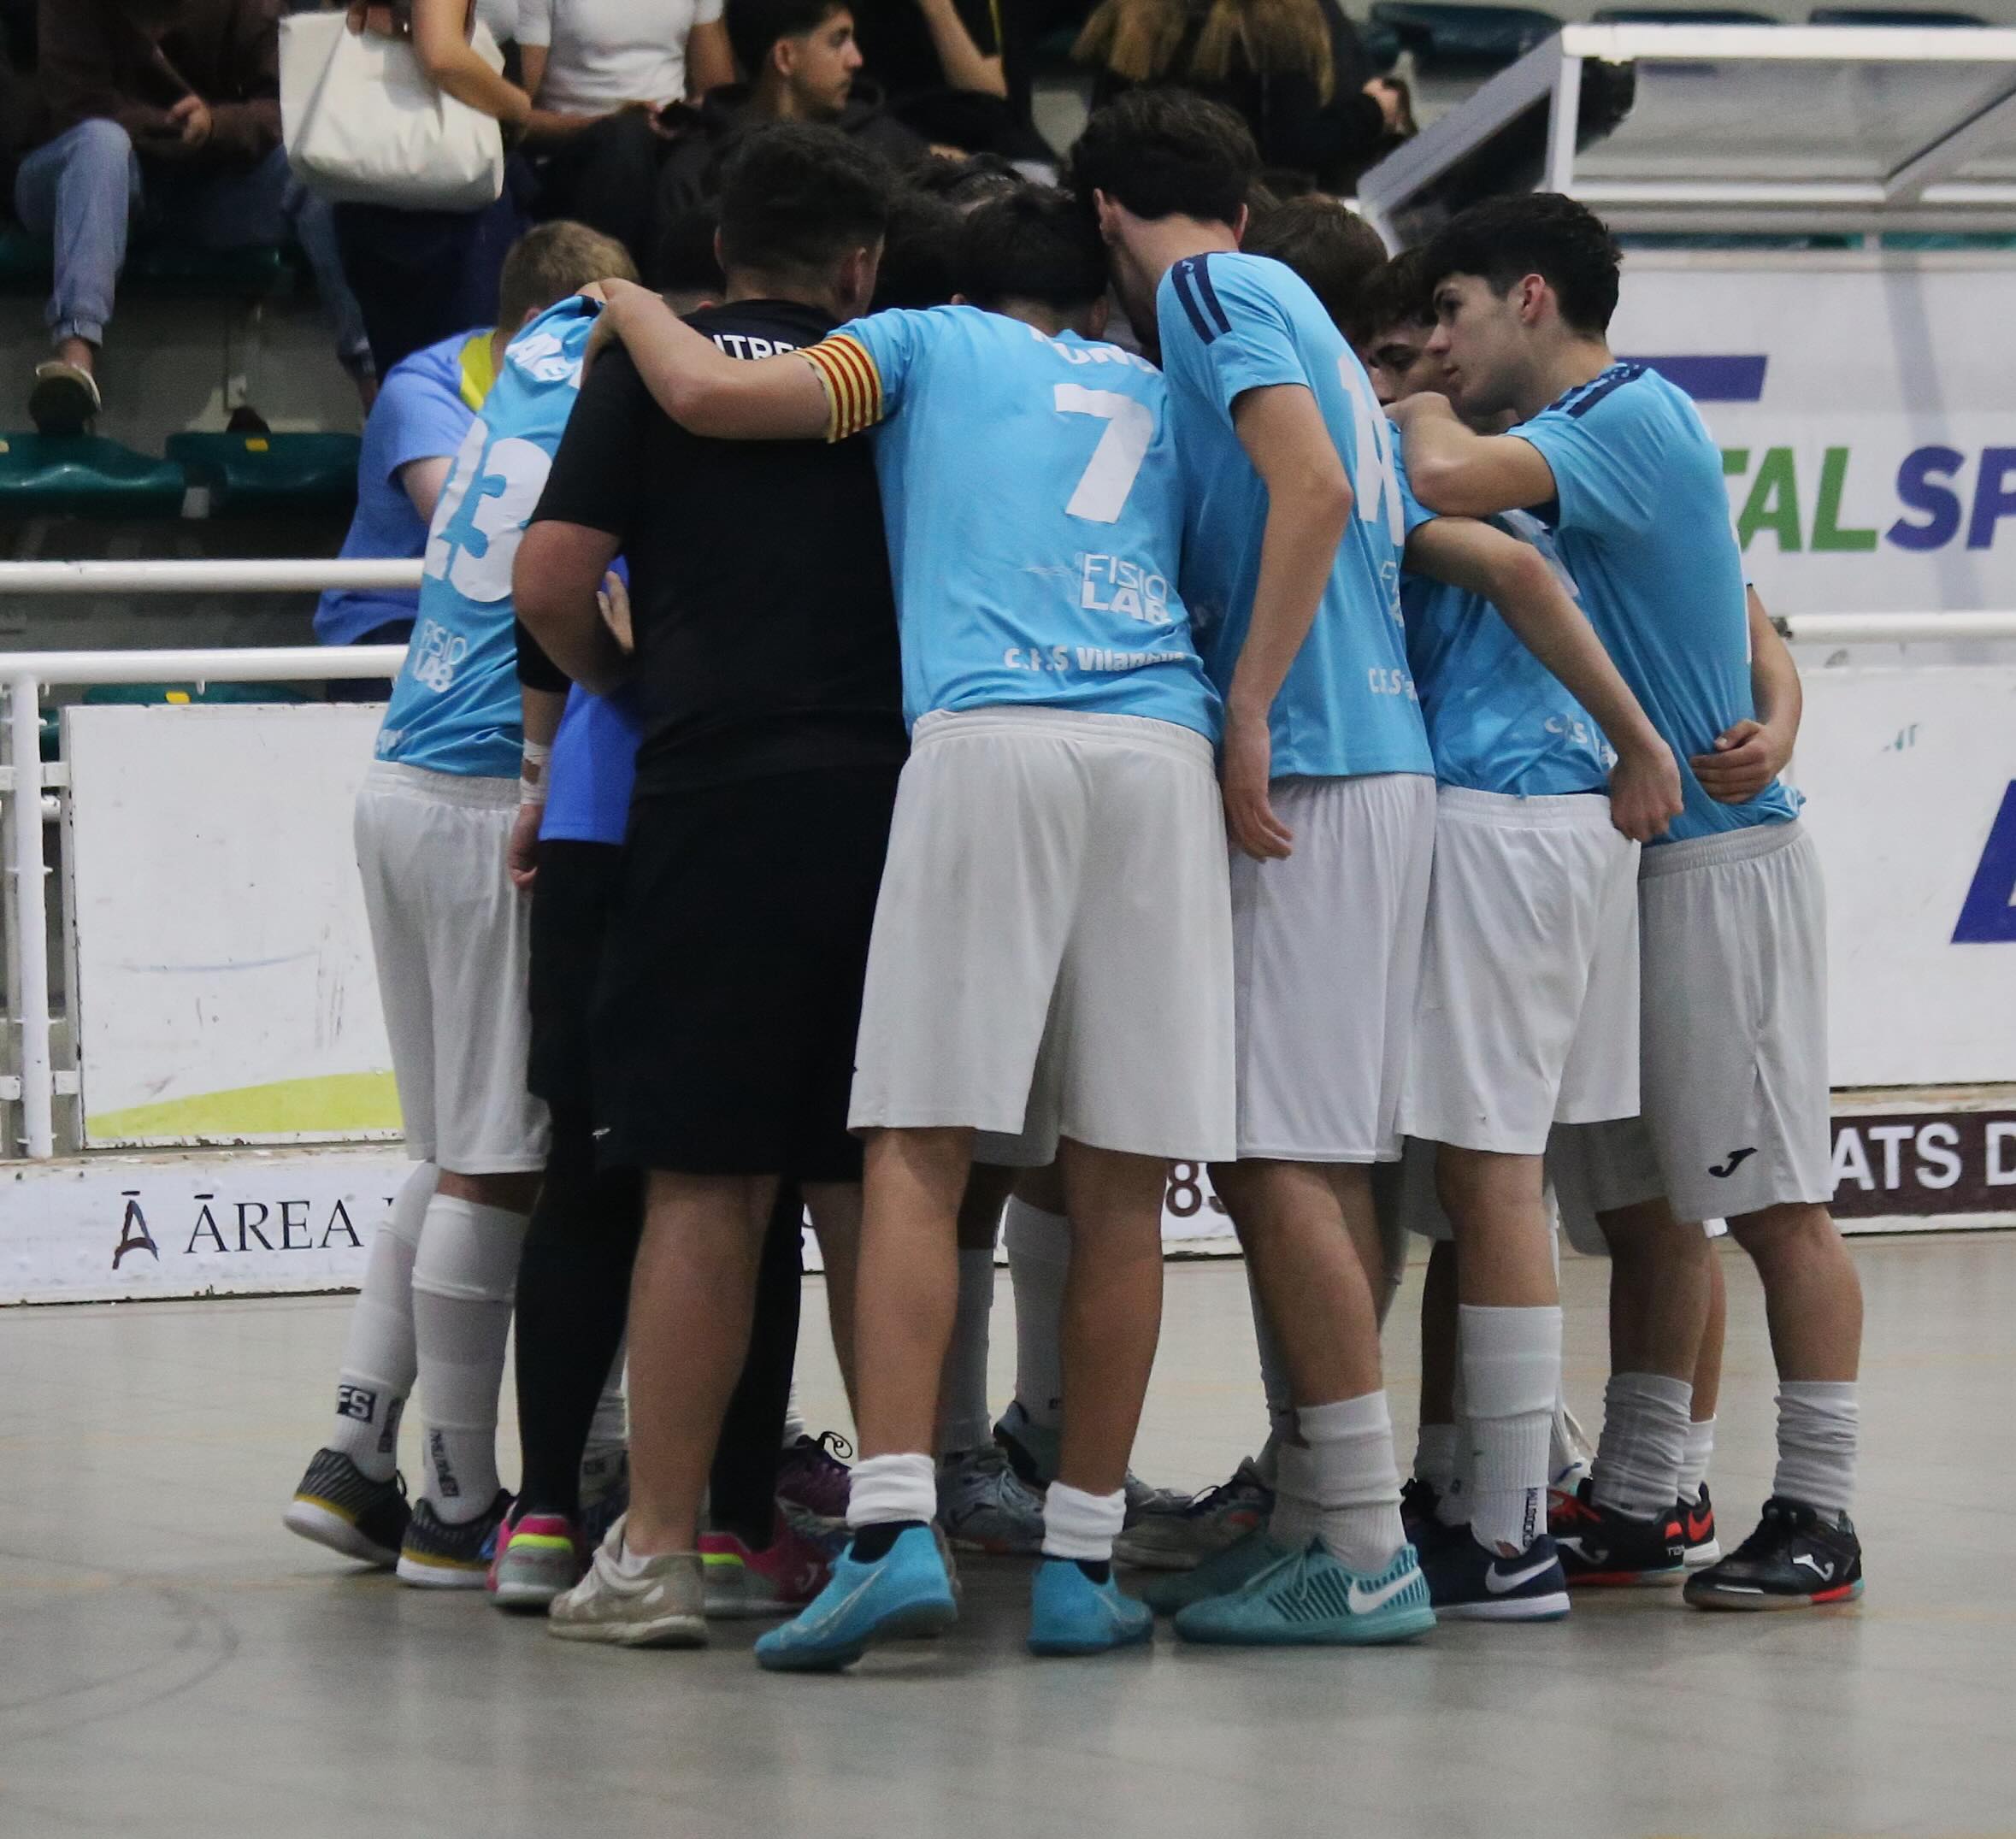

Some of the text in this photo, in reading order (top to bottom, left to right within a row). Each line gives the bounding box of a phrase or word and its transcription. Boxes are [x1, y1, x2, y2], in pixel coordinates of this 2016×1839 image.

[1053, 383, 1154, 523] 7
[1081, 553, 1168, 605] FISIO
[1081, 580, 1173, 626] LAB
[1165, 1160, 1228, 1217] 8
